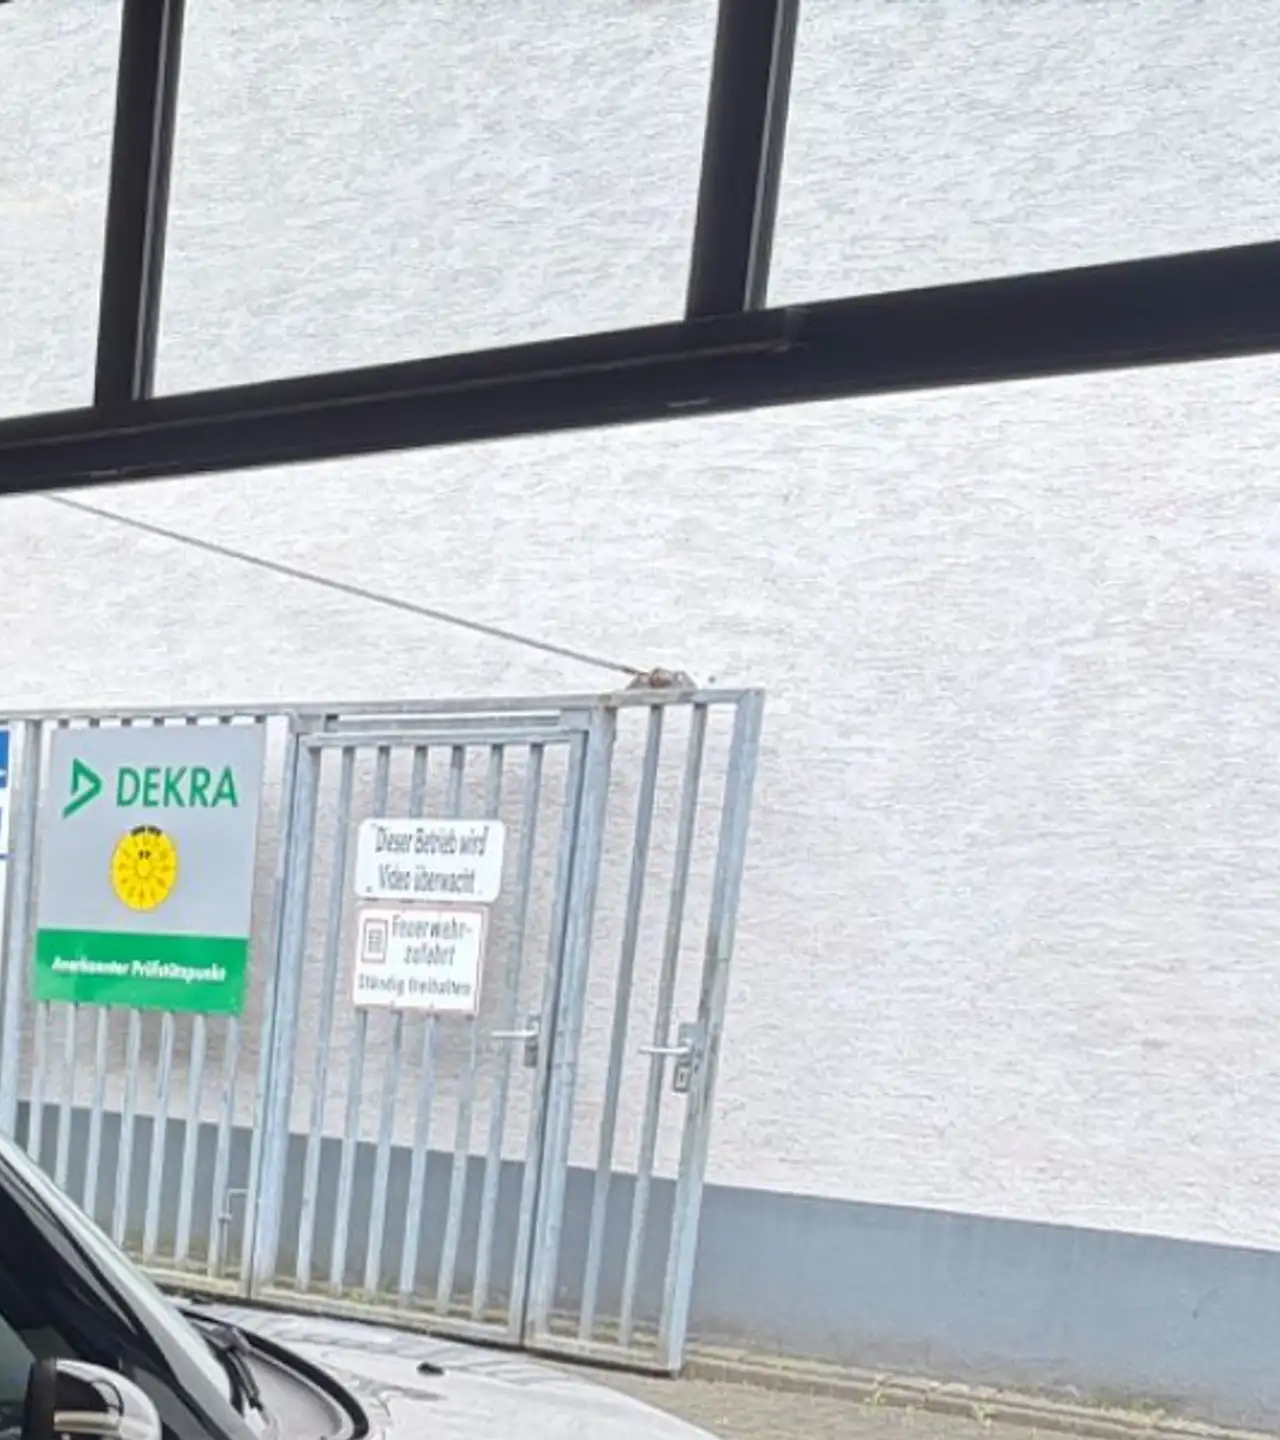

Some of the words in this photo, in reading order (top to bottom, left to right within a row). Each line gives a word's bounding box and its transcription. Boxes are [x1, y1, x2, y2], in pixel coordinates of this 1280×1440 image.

[116, 765, 240, 808] DEKRA
[375, 825, 413, 853] Dieser
[414, 826, 458, 854] Betrieb
[459, 825, 490, 857] wird
[378, 862, 411, 891] Video
[414, 864, 476, 893] überwacht
[392, 913, 474, 940] Feuerwehr-
[51, 954, 130, 976] Anerkannter
